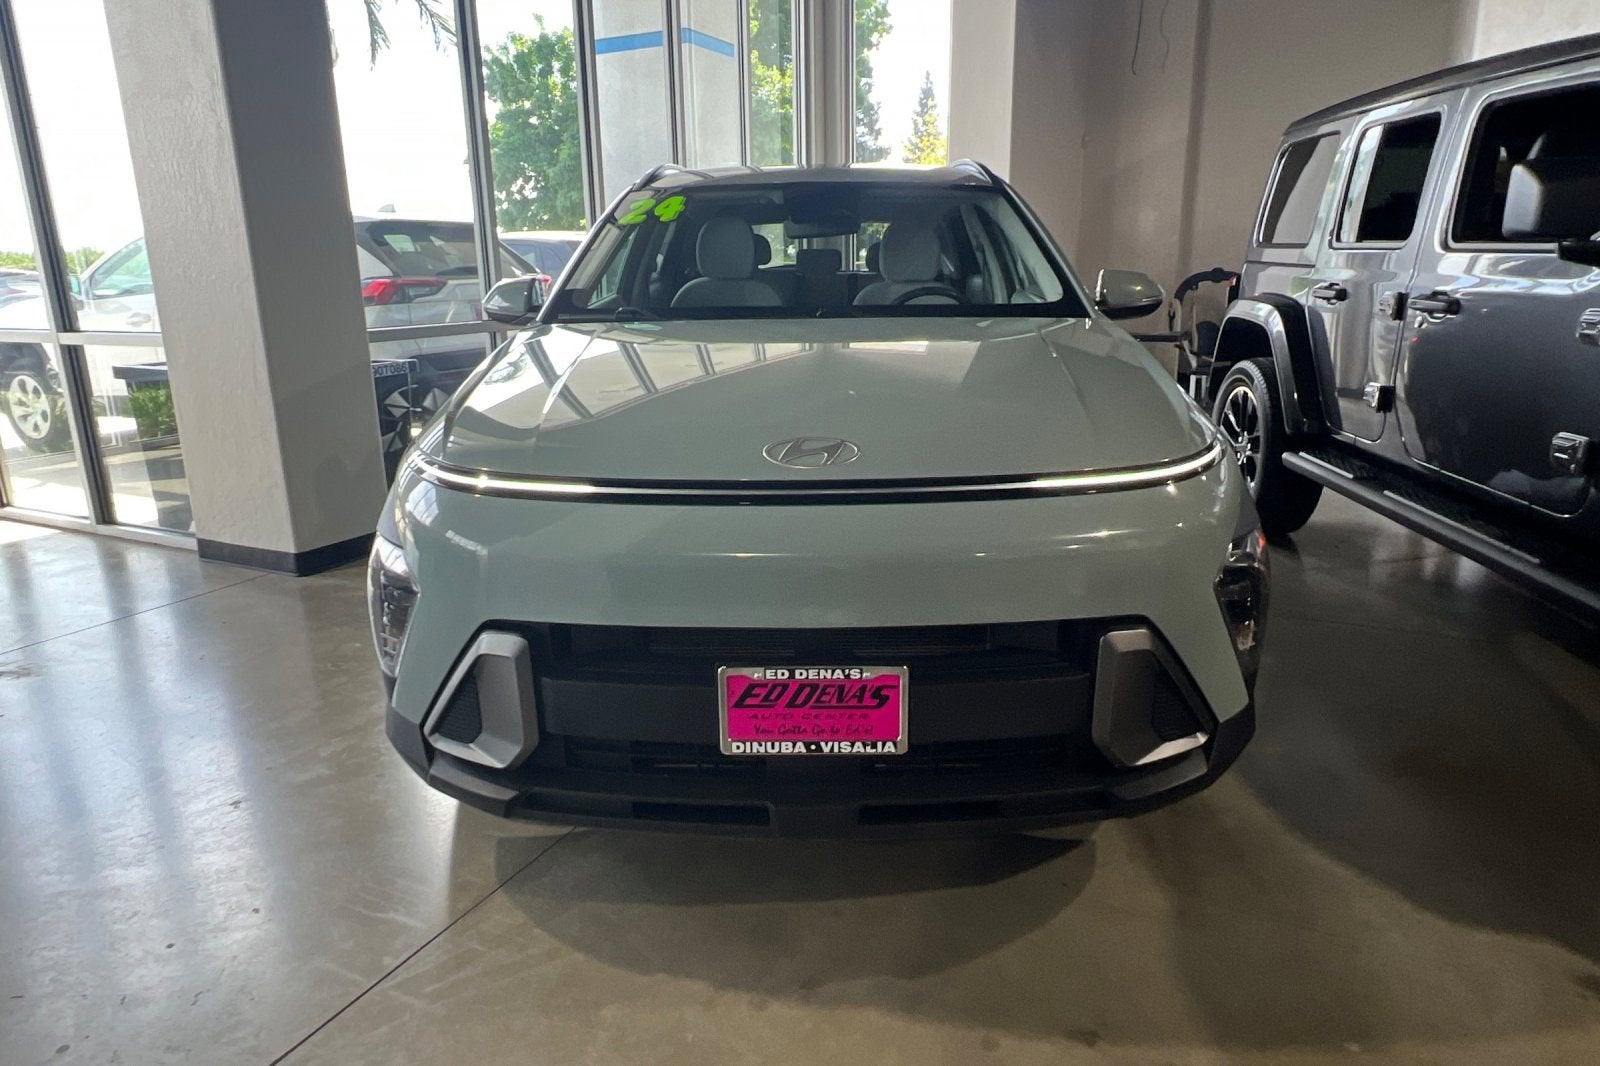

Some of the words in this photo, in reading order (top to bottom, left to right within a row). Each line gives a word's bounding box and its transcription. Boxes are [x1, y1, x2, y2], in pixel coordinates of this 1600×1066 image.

[617, 195, 687, 225] 24
[766, 669, 790, 680] ED
[795, 668, 861, 680] DENA'S
[733, 683, 790, 709] ED
[785, 683, 897, 709] DENA'S
[731, 741, 807, 753] DINUBA
[821, 741, 896, 753] VISALIA
